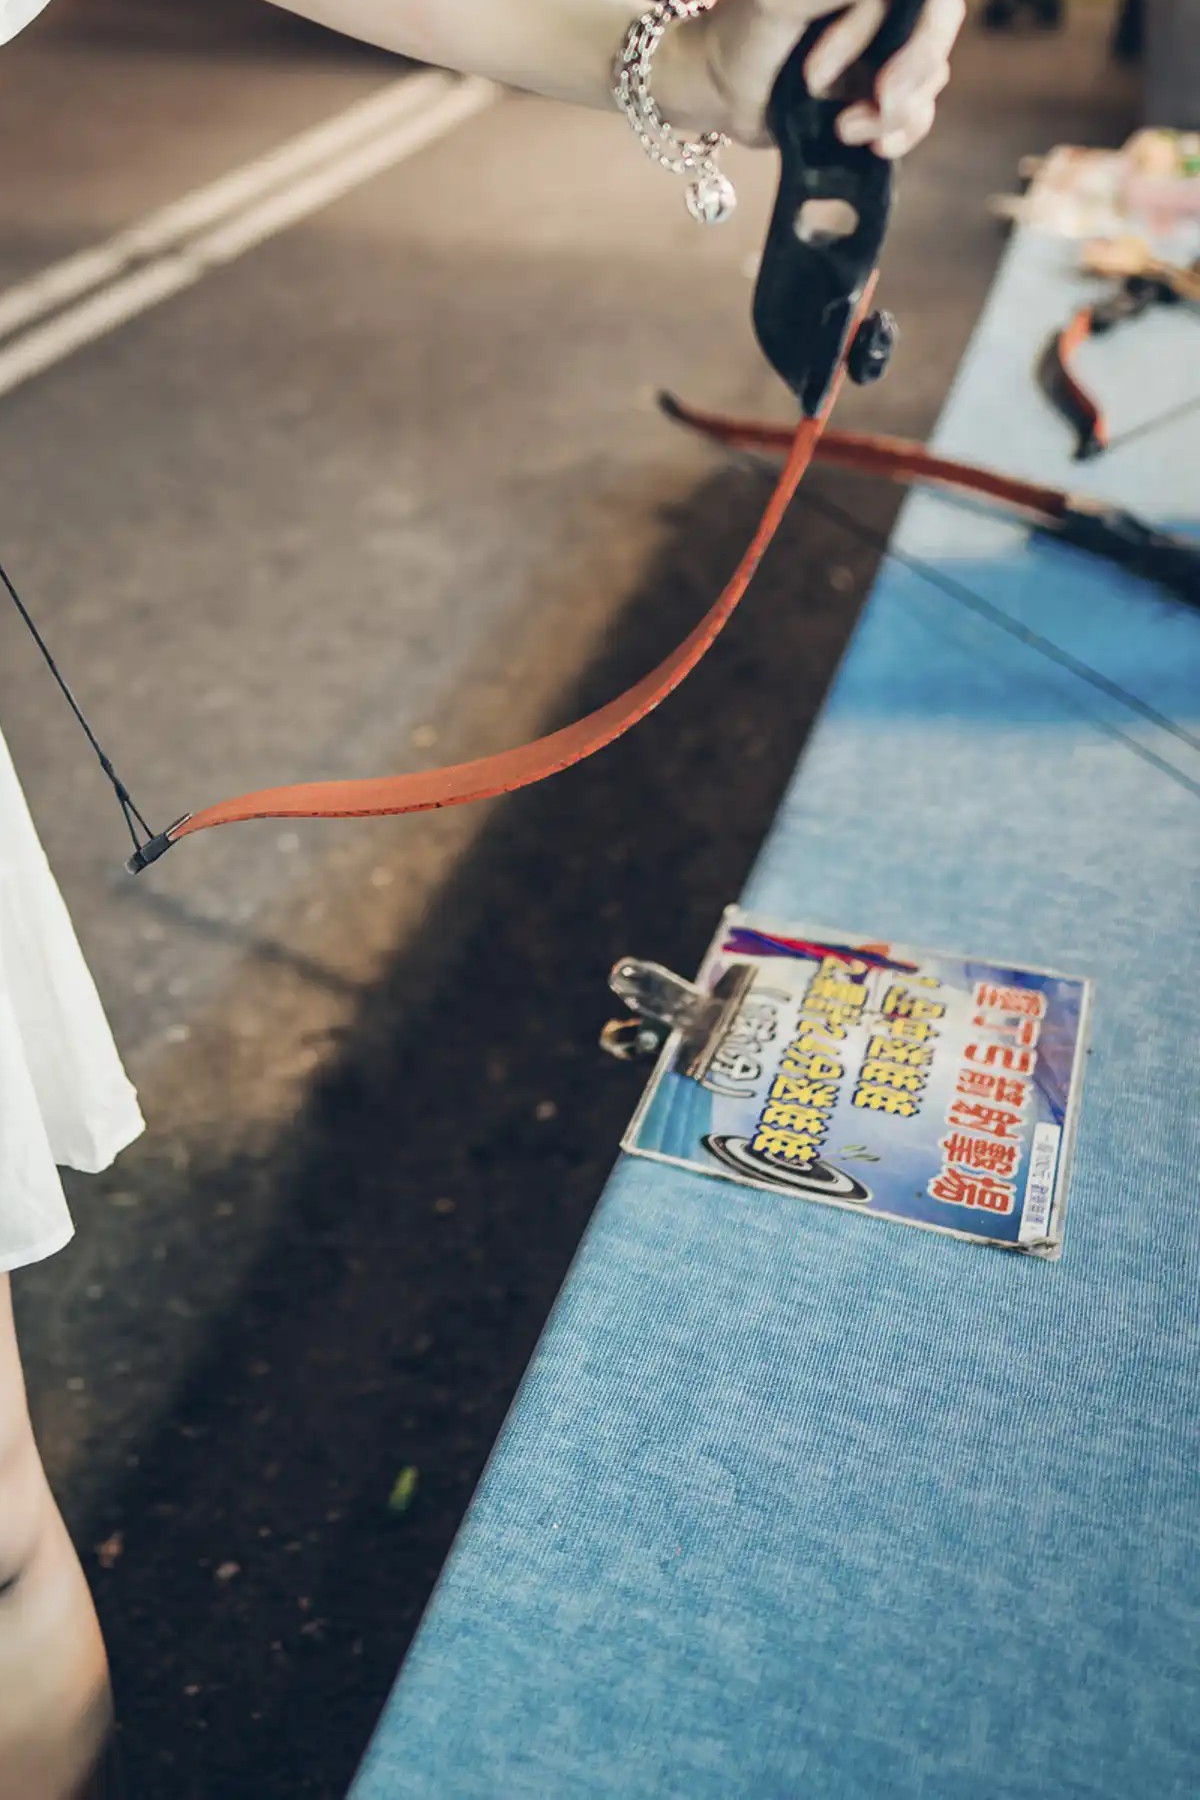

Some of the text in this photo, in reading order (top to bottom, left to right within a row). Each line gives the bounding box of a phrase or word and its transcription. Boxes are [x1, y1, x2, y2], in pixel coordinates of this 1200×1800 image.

[929, 982, 1047, 1215] 墾丁弓箭射擊場
